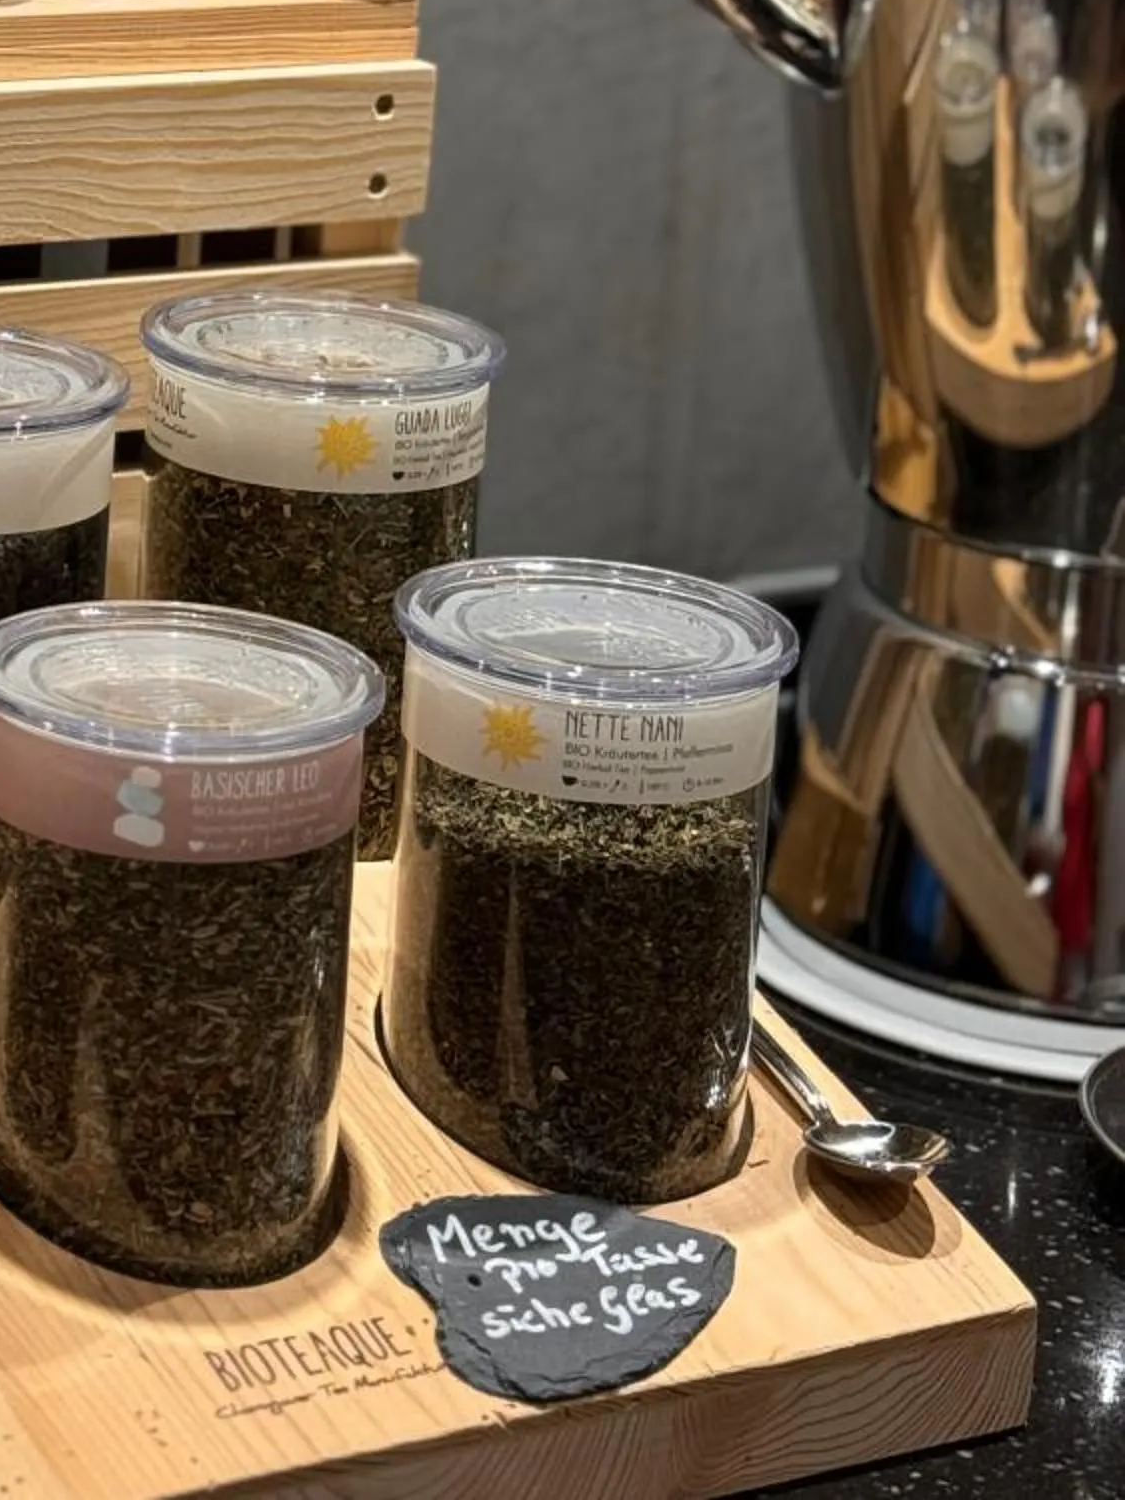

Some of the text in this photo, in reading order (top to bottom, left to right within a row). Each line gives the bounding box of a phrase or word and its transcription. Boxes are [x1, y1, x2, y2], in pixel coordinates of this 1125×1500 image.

[564, 710, 684, 742] NETTE NANI
[565, 742, 590, 757] BIO
[191, 760, 320, 800] BASISCHER LEO
[426, 1211, 606, 1264] Menge
[483, 1238, 704, 1294] pro Tasse
[599, 1276, 702, 1335] Glas
[204, 1316, 412, 1393] BIOTEAQUE
